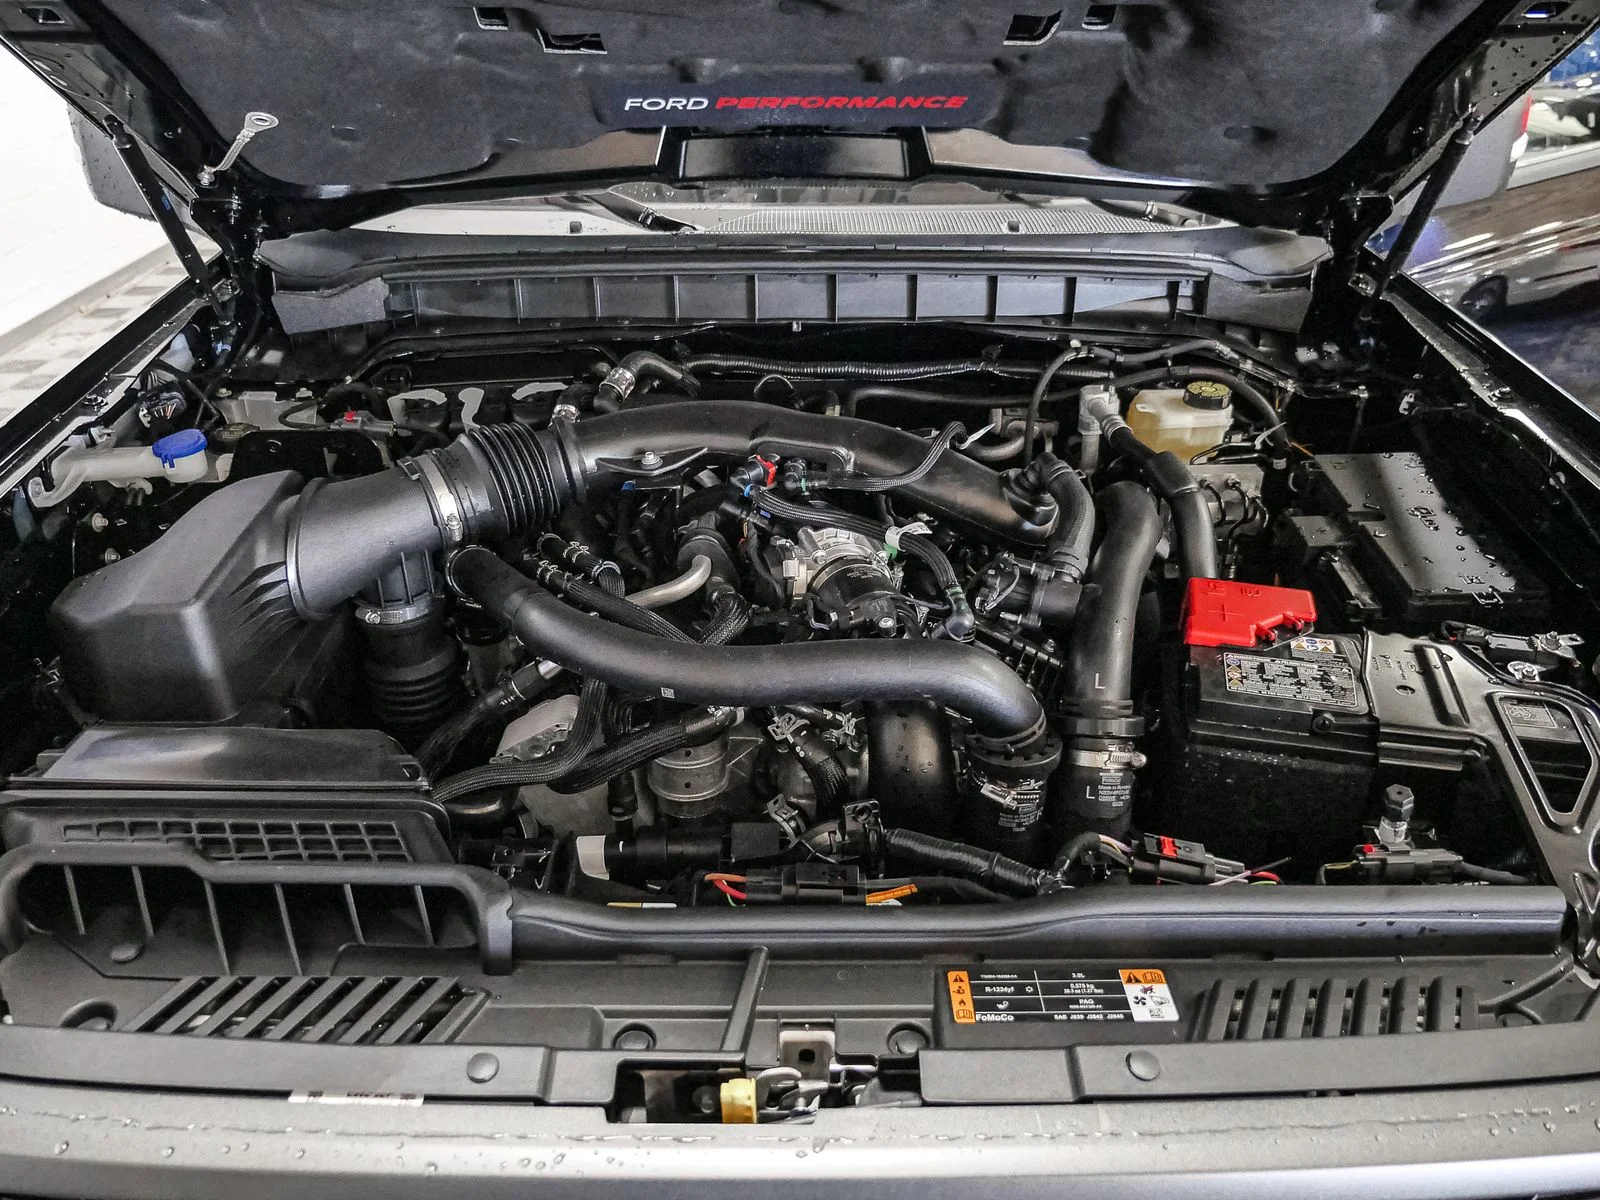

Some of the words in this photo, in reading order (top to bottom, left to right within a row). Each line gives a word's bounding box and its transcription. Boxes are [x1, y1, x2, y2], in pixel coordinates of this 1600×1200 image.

[624, 97, 710, 111] FORD
[715, 95, 969, 110] PERFORMANCE
[1095, 672, 1106, 689] L
[1085, 786, 1095, 800] L
[976, 1013, 1015, 1022] FoMoCo
